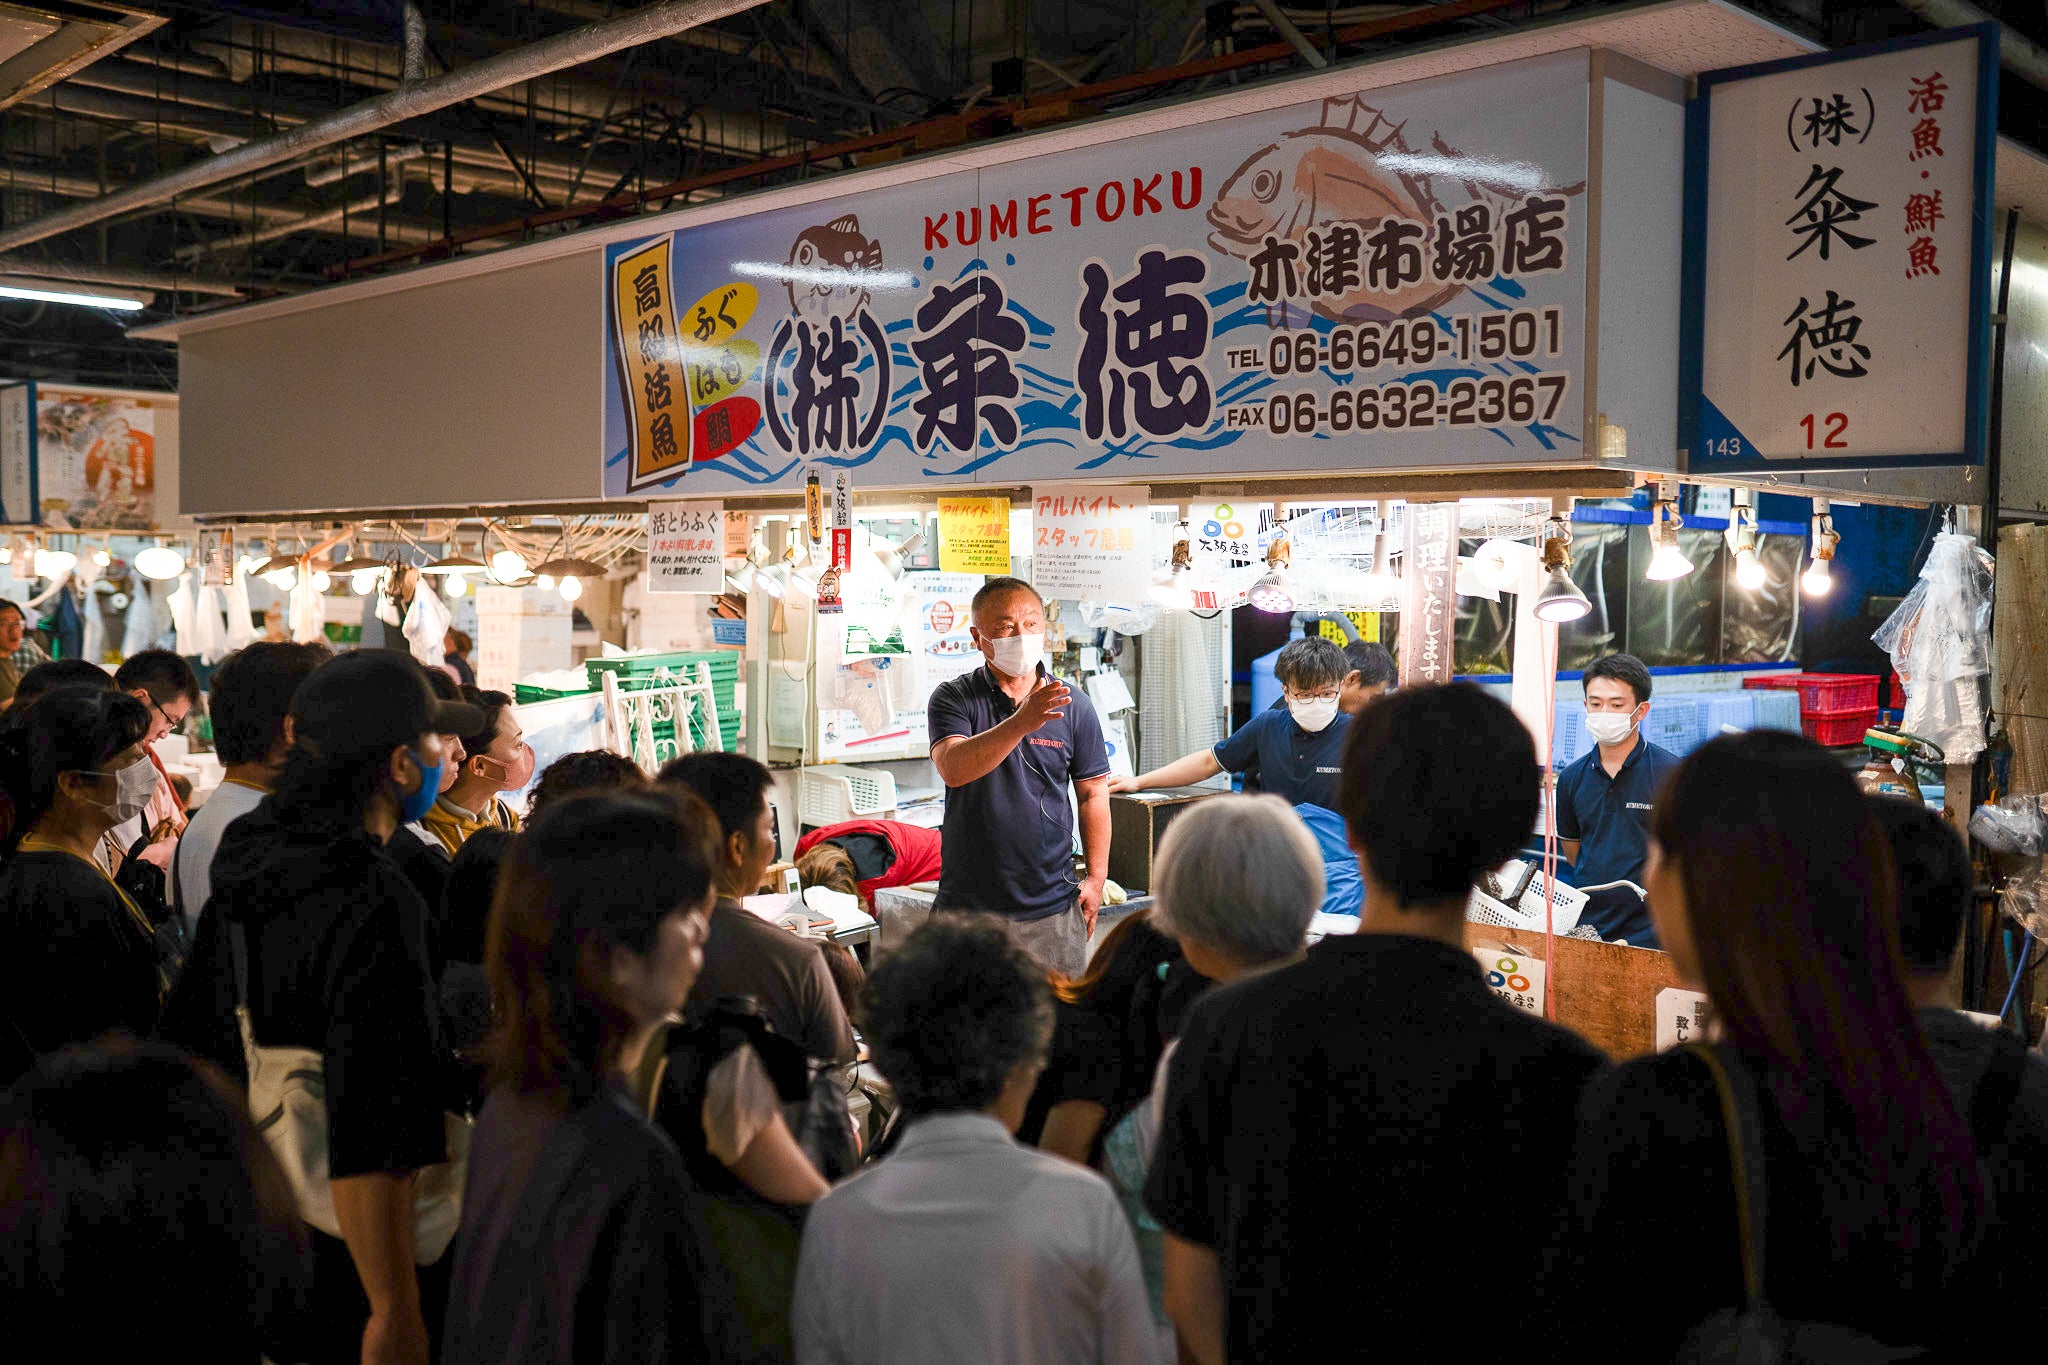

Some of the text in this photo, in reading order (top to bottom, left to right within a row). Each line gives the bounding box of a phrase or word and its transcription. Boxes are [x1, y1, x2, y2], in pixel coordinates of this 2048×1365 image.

[1904, 71, 1950, 280] 活魚・鮮魚
[925, 167, 1202, 251] KUMETOKU
[1248, 197, 1567, 303] 木津市場店
[695, 288, 738, 343] ふぐ
[1227, 310, 1560, 376] TEL 06-6649-1501
[633, 264, 678, 463] 高級活魚
[696, 349, 742, 400] はも
[706, 407, 732, 451] 鯛
[1228, 376, 1567, 435] FAX 06-6632-2367
[1800, 412, 1849, 450] 12
[1706, 438, 1740, 456] 143
[653, 511, 718, 535] 活とらふぐ
[1030, 738, 1063, 748] KUMETOKU
